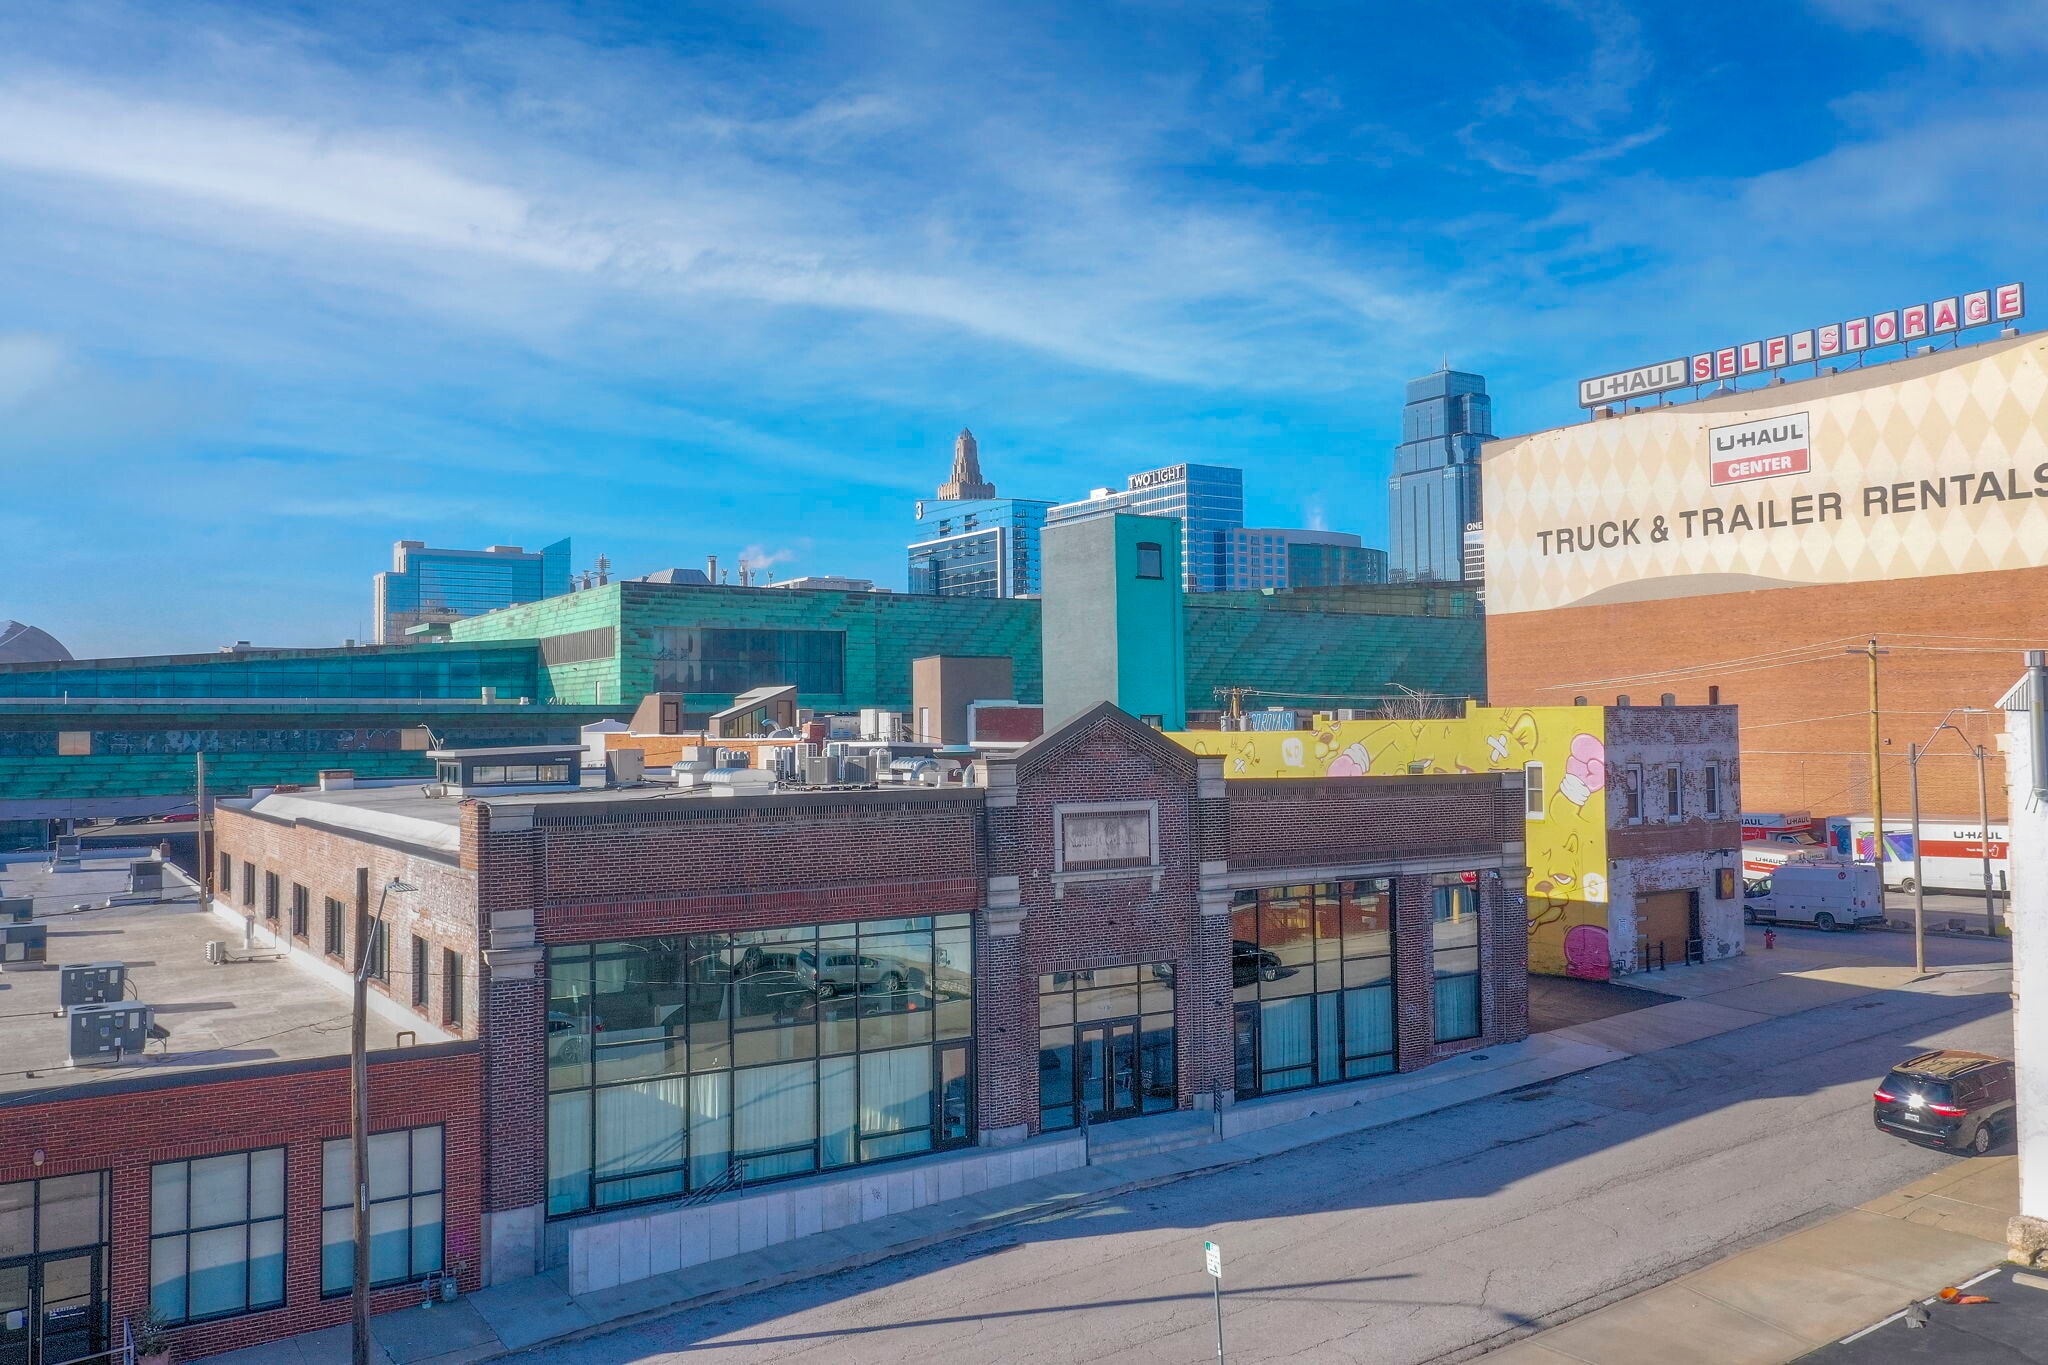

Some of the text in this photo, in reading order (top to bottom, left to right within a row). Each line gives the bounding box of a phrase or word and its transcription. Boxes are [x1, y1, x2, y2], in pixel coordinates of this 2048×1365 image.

[1586, 288, 2019, 401] U-HAUL SELF-STORAGE
[1716, 424, 1804, 451] U-HAUL
[1128, 466, 1185, 489] TWO LIGHT
[1727, 456, 1792, 478] CENTER
[915, 501, 923, 520] 3
[1537, 462, 2048, 556] TRUCK & TRAILER RENTALS
[1466, 521, 1483, 531] ONE
